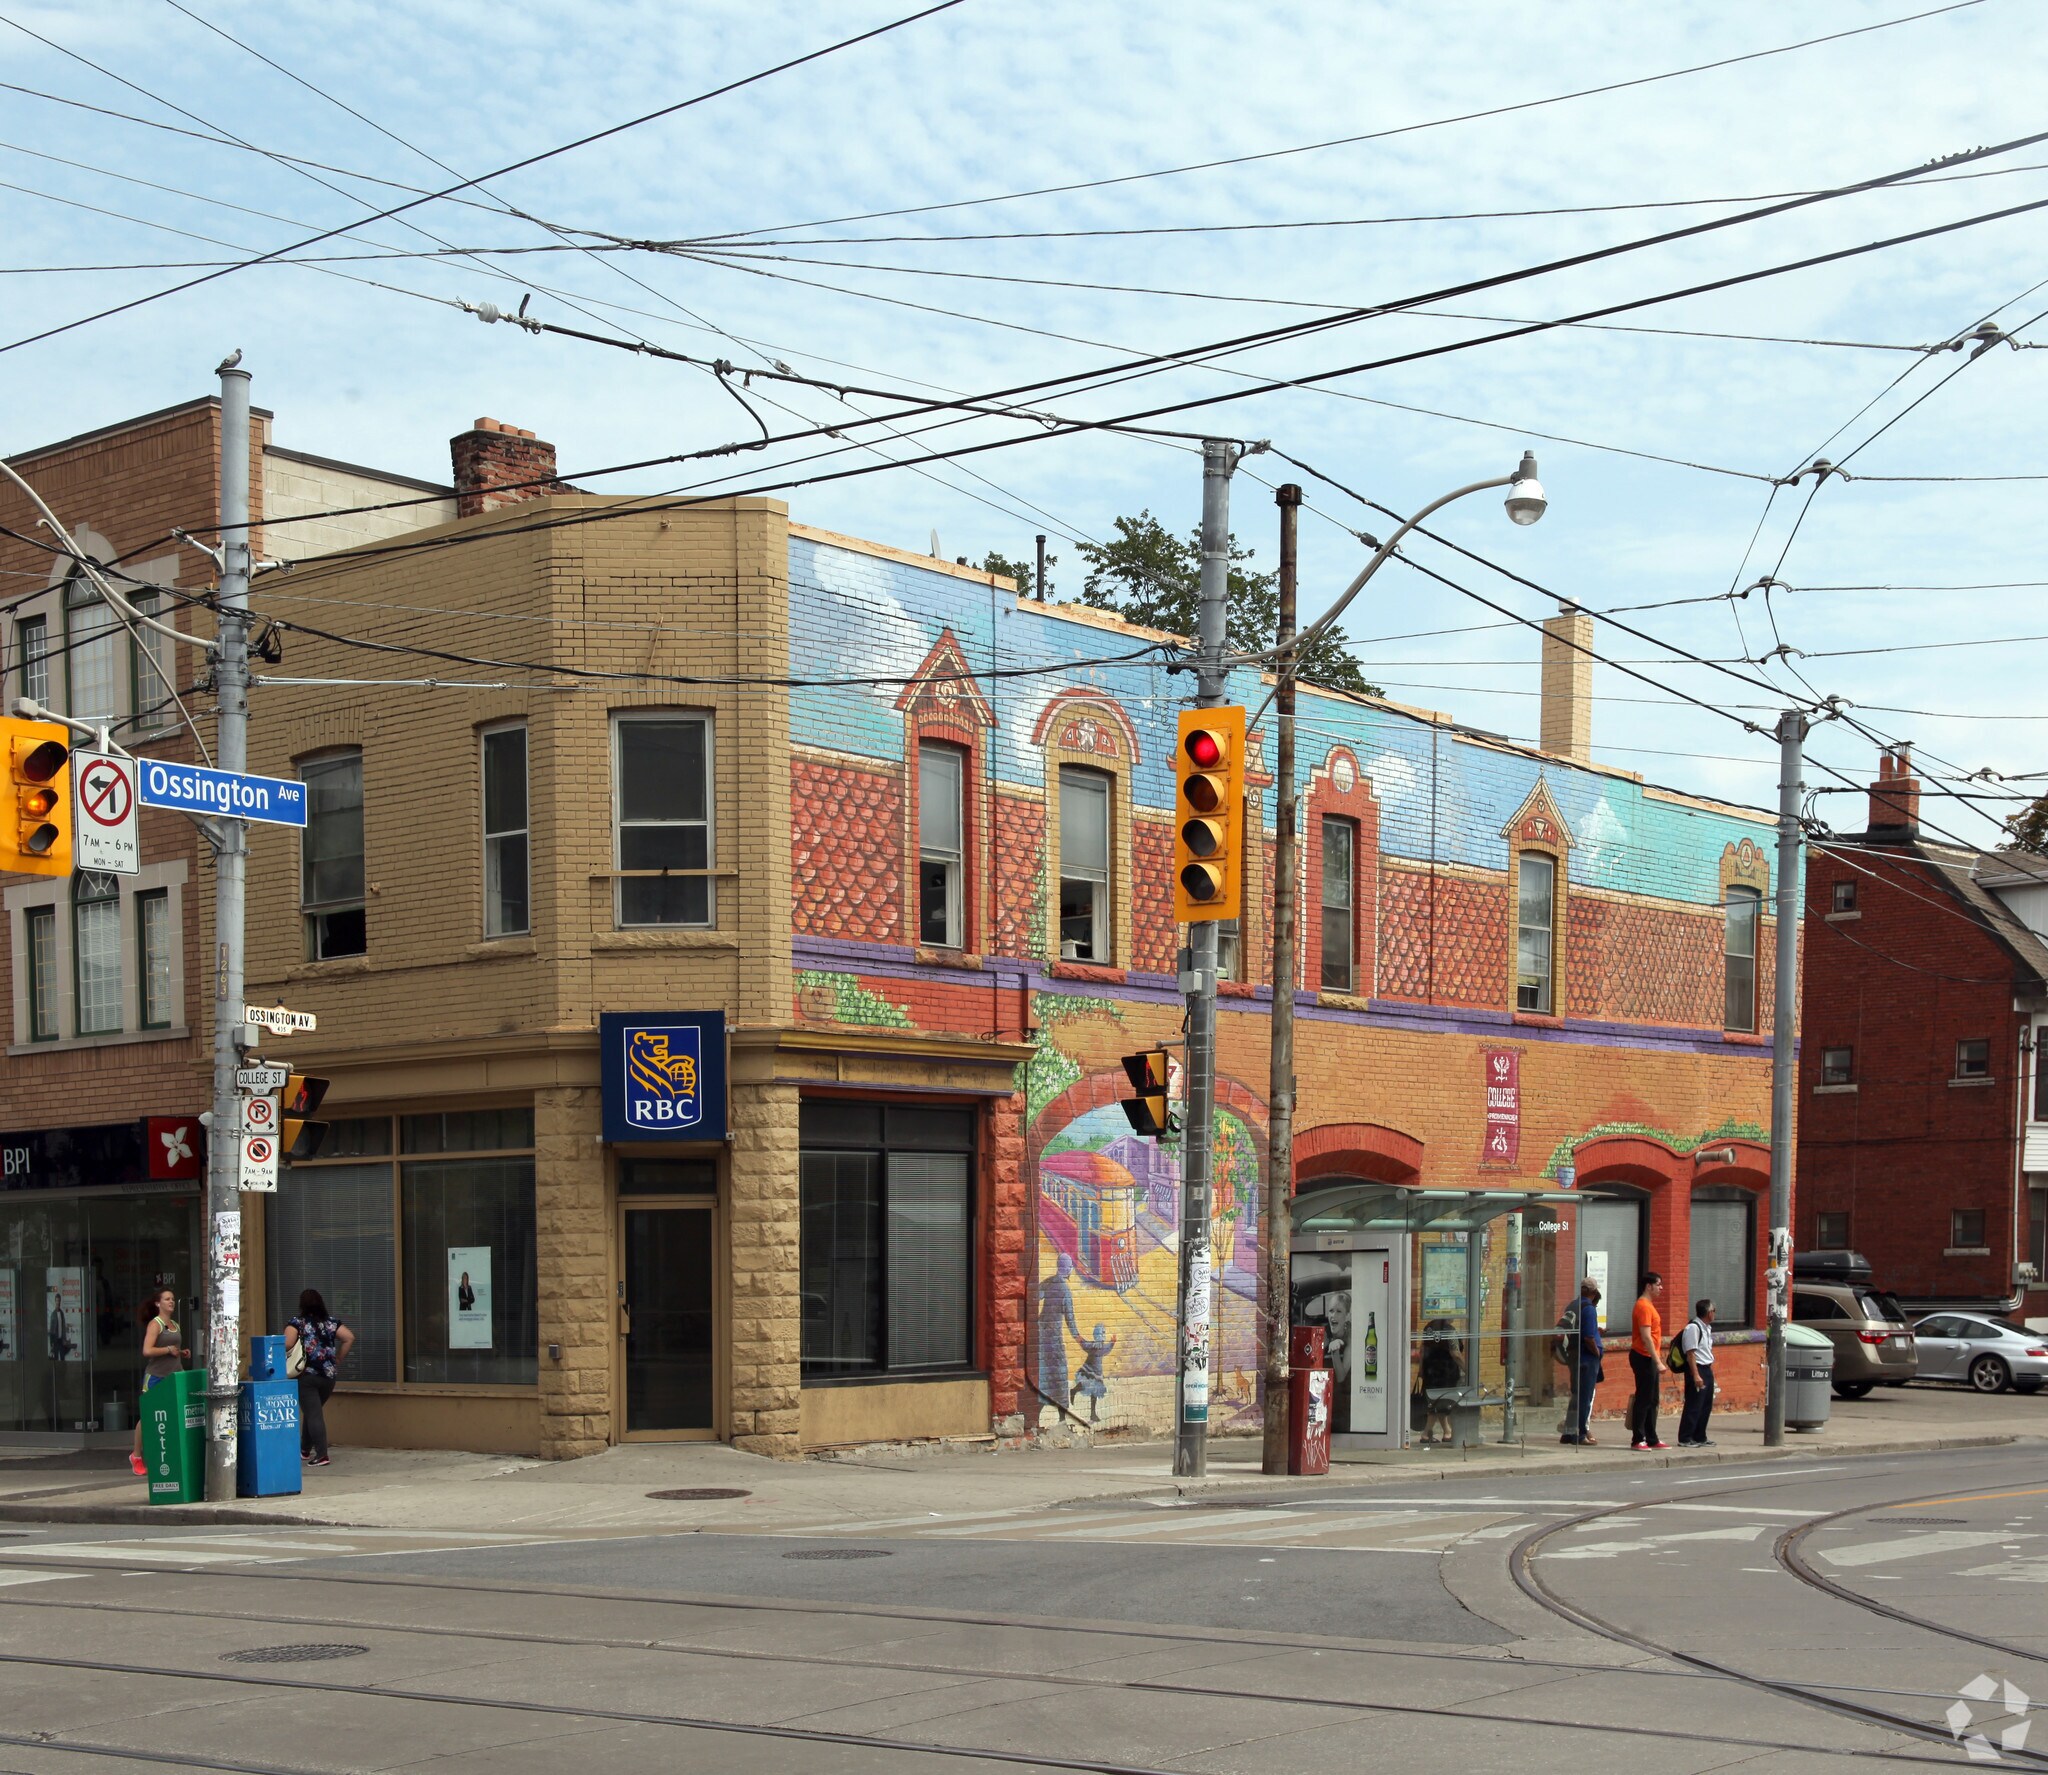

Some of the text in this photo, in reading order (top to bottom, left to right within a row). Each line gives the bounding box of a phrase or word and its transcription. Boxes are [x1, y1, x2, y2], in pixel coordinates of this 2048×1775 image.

[149, 765, 300, 812] Ossington Ave
[220, 946, 228, 995] T263
[249, 1009, 296, 1026] OSSINGTON
[238, 1071, 269, 1084] COLLEGE
[1488, 1086, 1515, 1108] COLLEGE
[634, 1099, 694, 1120] RBC
[3, 1147, 31, 1175] BPI
[1538, 1220, 1569, 1233] College St
[162, 1272, 176, 1285] BPI
[1359, 1385, 1383, 1394] PERONI
[255, 1398, 298, 1410] TRONTO
[257, 1407, 297, 1423] STAR
